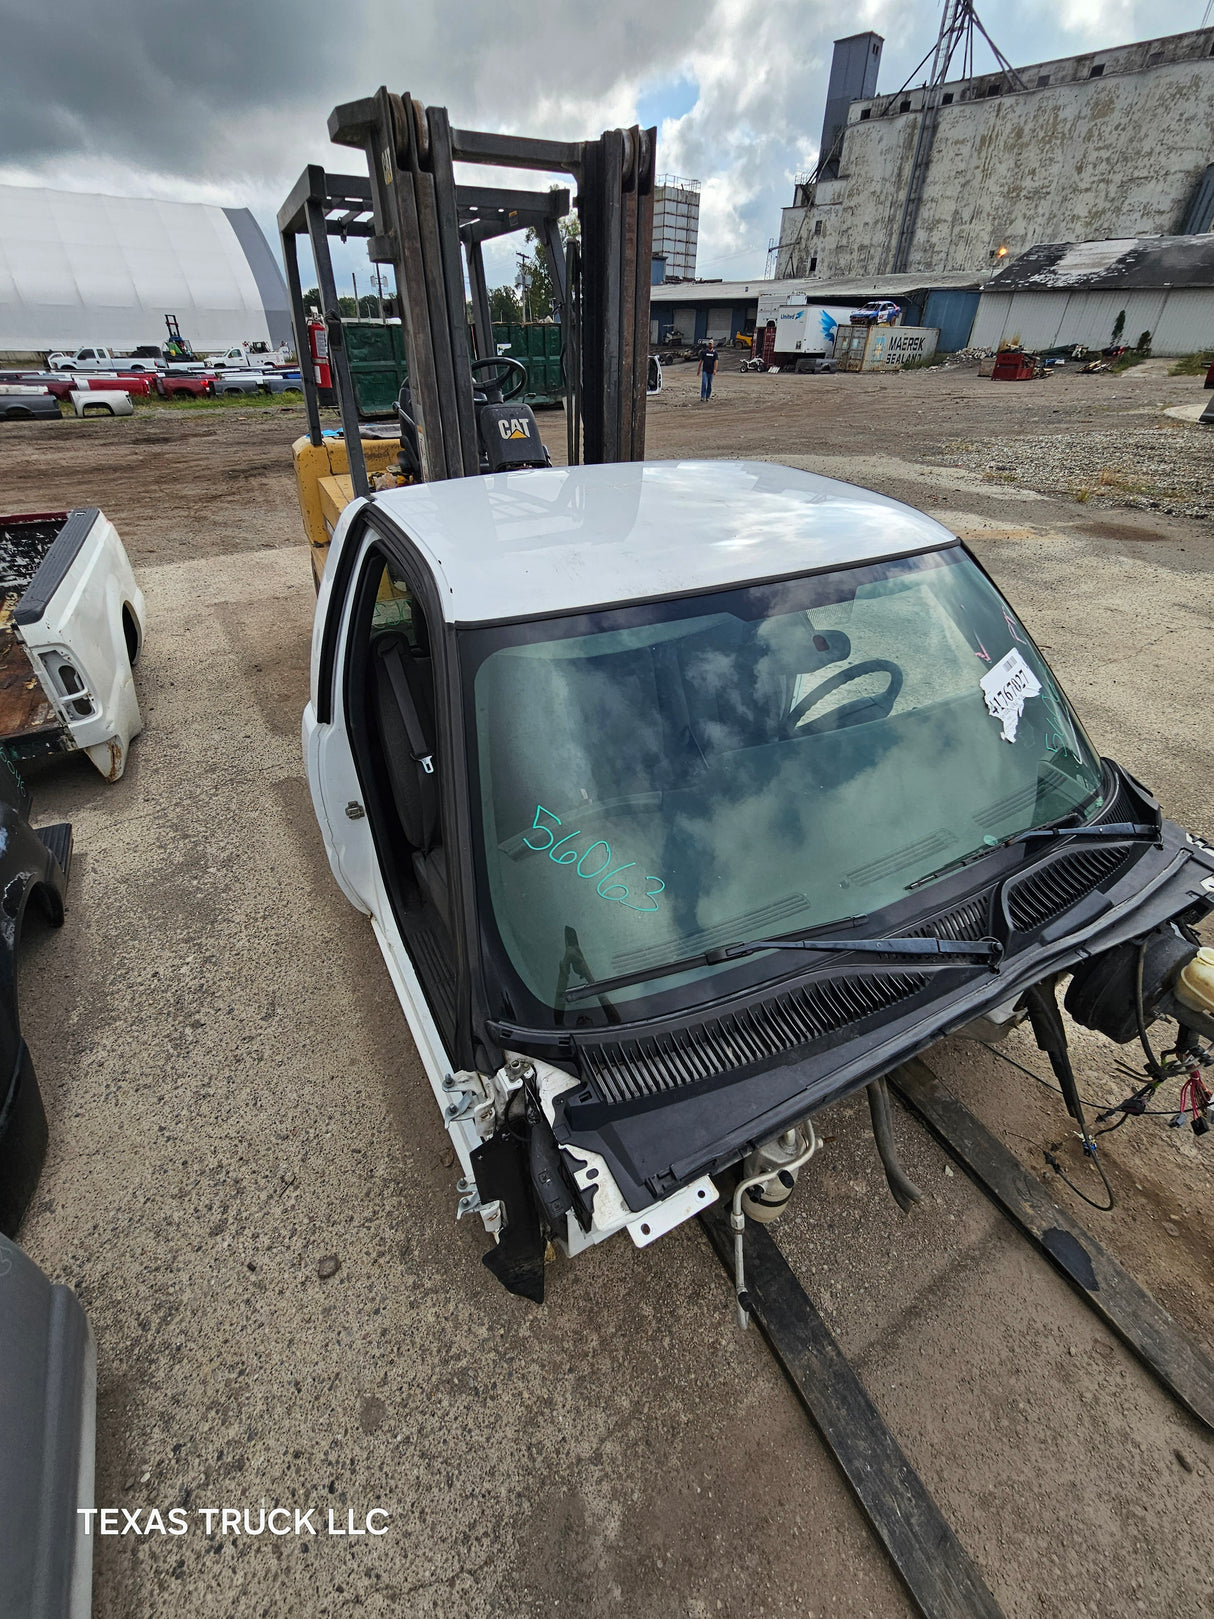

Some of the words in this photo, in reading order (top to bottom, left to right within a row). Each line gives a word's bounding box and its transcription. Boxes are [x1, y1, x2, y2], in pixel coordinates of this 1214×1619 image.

[889, 336, 926, 351] MAERSK
[498, 418, 531, 440] CAT
[523, 805, 665, 912] 56063
